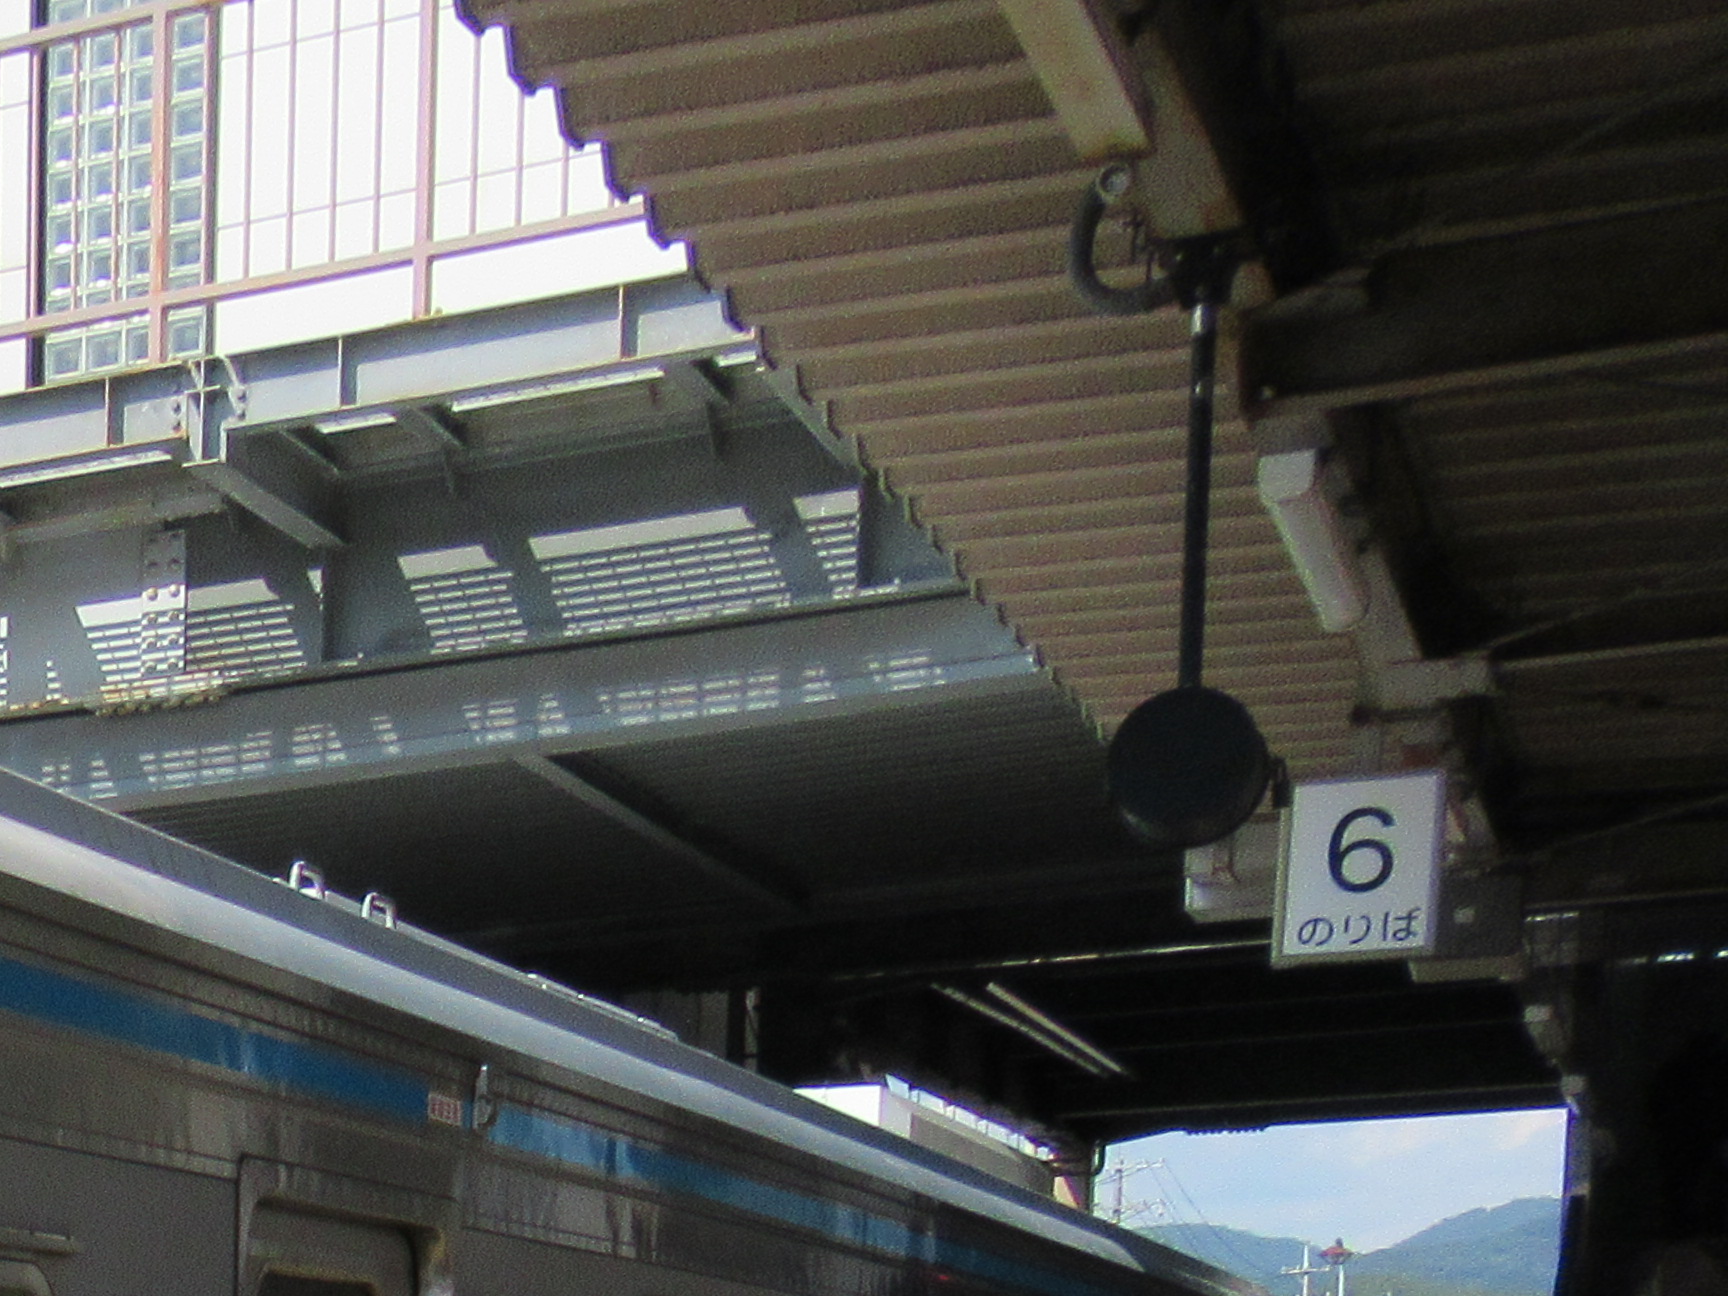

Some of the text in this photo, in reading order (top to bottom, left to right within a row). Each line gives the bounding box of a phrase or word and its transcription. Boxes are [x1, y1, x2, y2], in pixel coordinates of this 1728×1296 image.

[1327, 806, 1395, 893] 6
[1296, 907, 1422, 947] のりば
